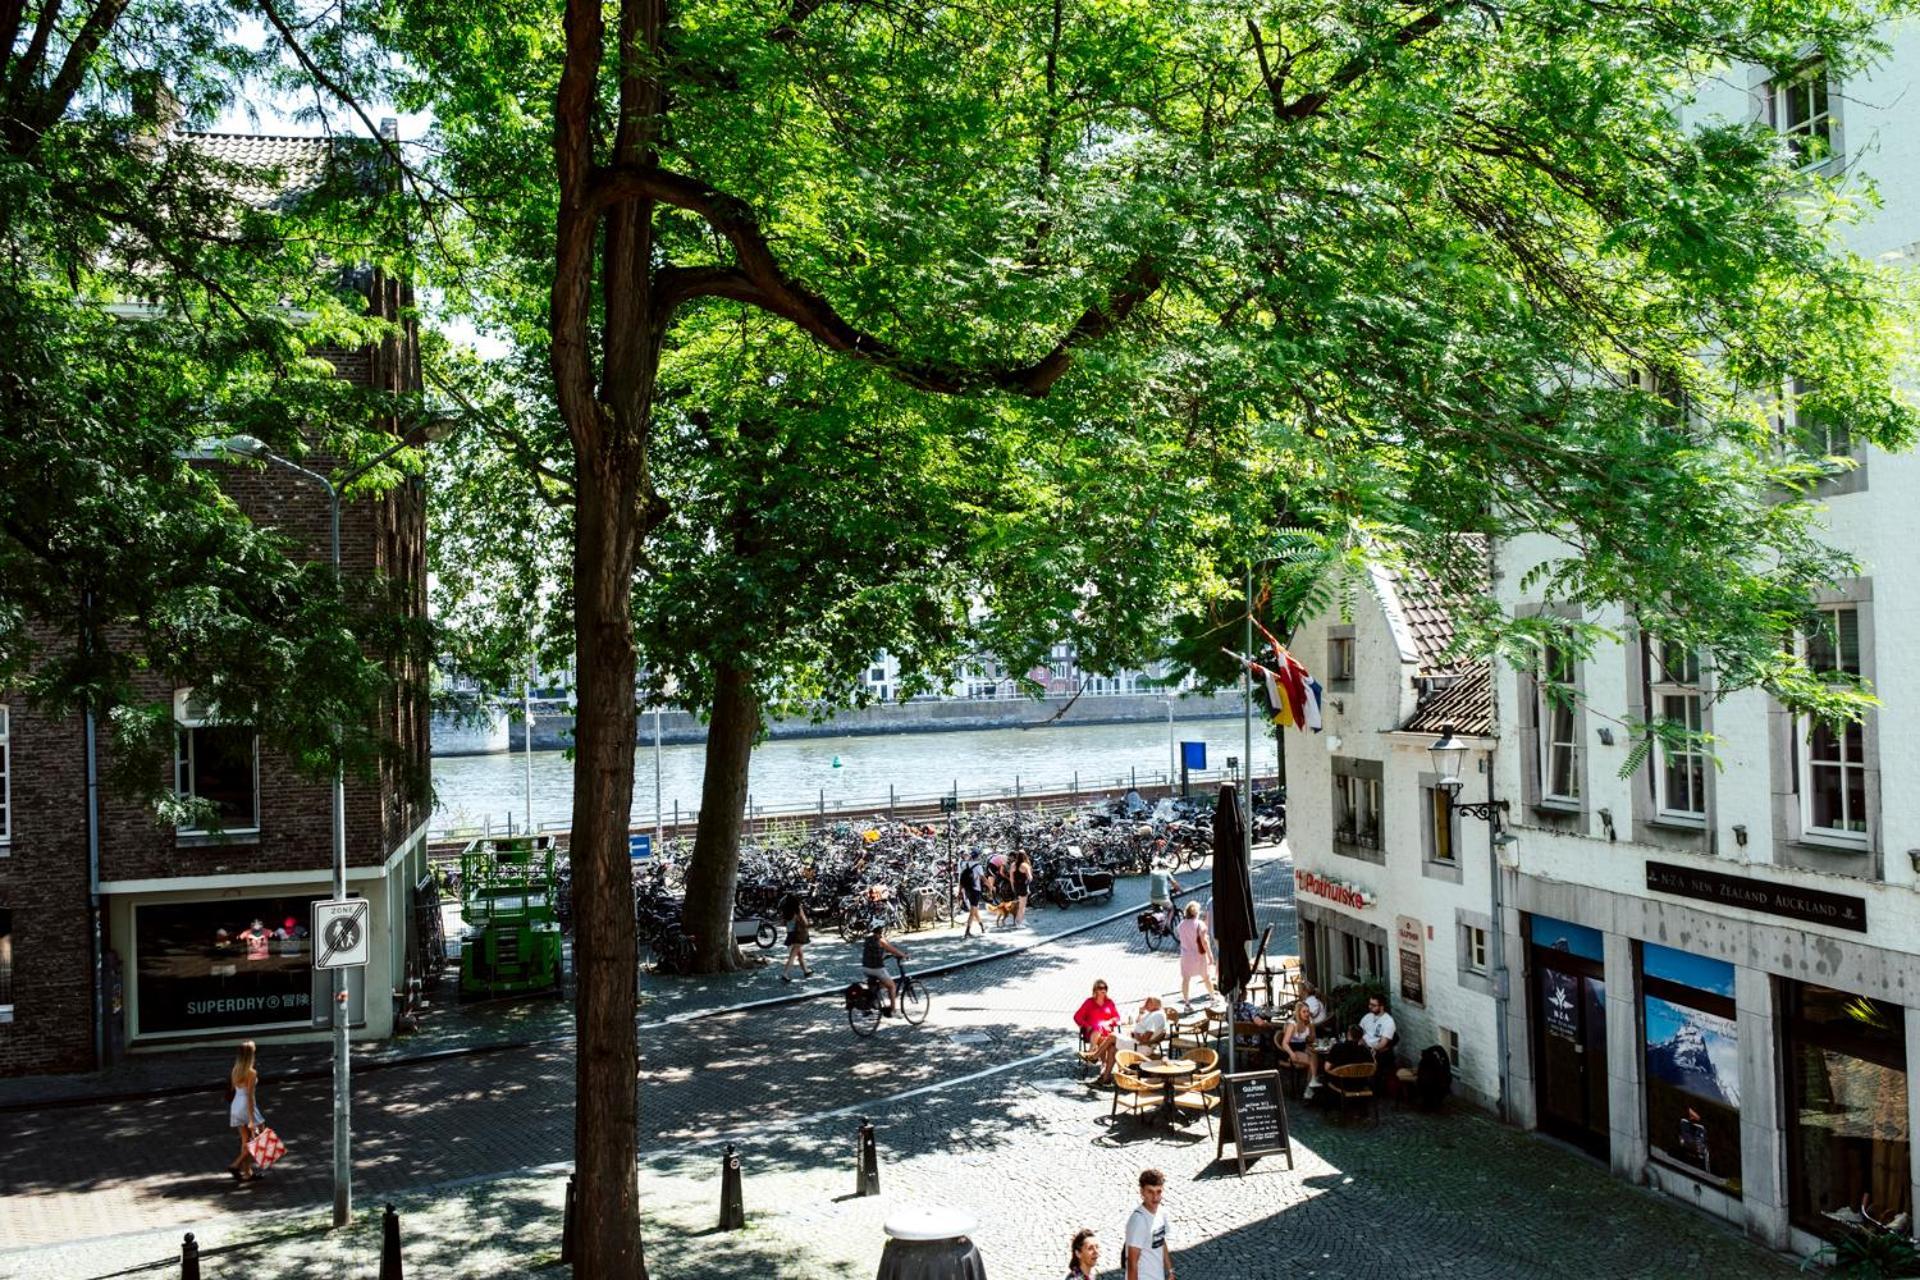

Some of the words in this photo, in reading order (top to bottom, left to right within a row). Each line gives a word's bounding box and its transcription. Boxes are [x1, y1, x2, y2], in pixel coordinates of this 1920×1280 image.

[1692, 880, 1713, 893] NEW
[1720, 883, 1768, 904] ZEALAND
[1775, 895, 1837, 917] AUCKLAND
